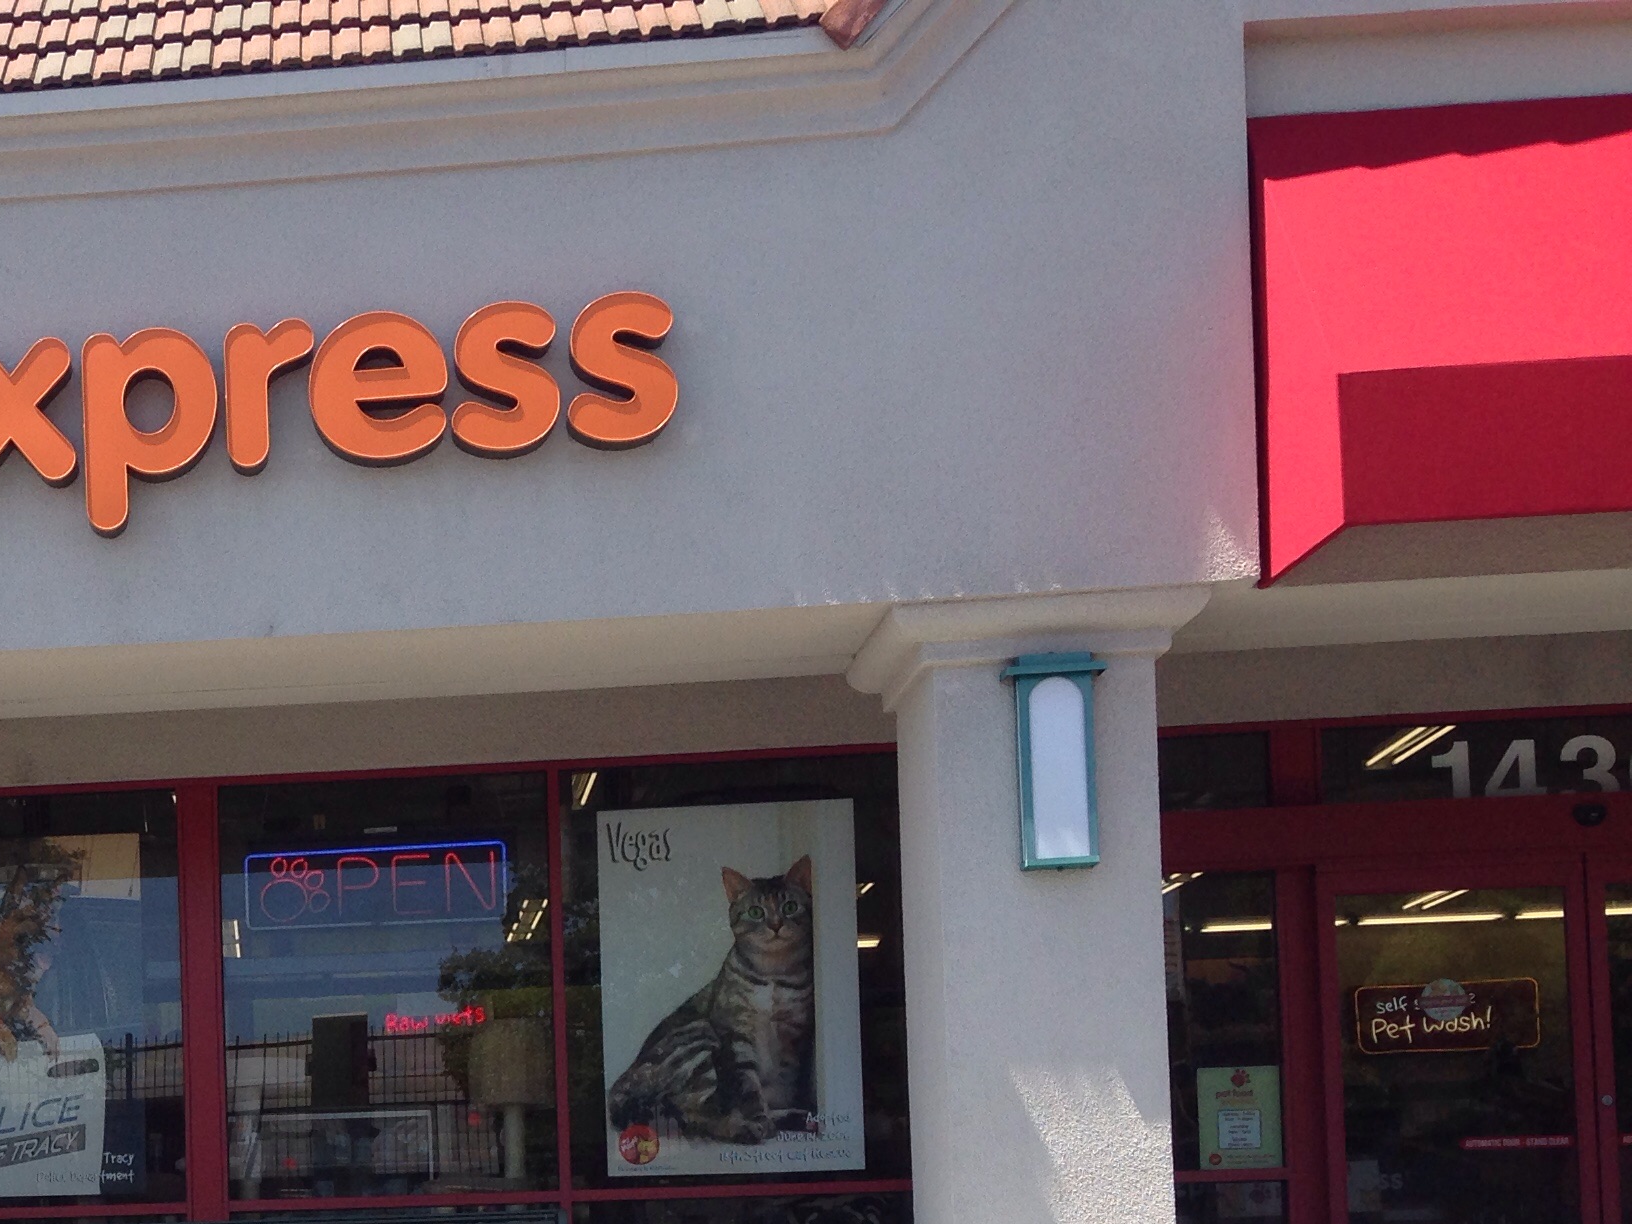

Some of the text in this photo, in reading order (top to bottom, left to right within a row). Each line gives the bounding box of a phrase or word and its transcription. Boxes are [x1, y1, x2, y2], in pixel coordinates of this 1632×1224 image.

[1431, 734, 1632, 798] 143
[605, 821, 671, 872] Vegas
[1375, 995, 1408, 1014] self
[385, 1012, 428, 1032] Raw
[1371, 1014, 1416, 1044] Pet
[11, 1130, 81, 1162] TRACY
[103, 1151, 135, 1166] Tracy
